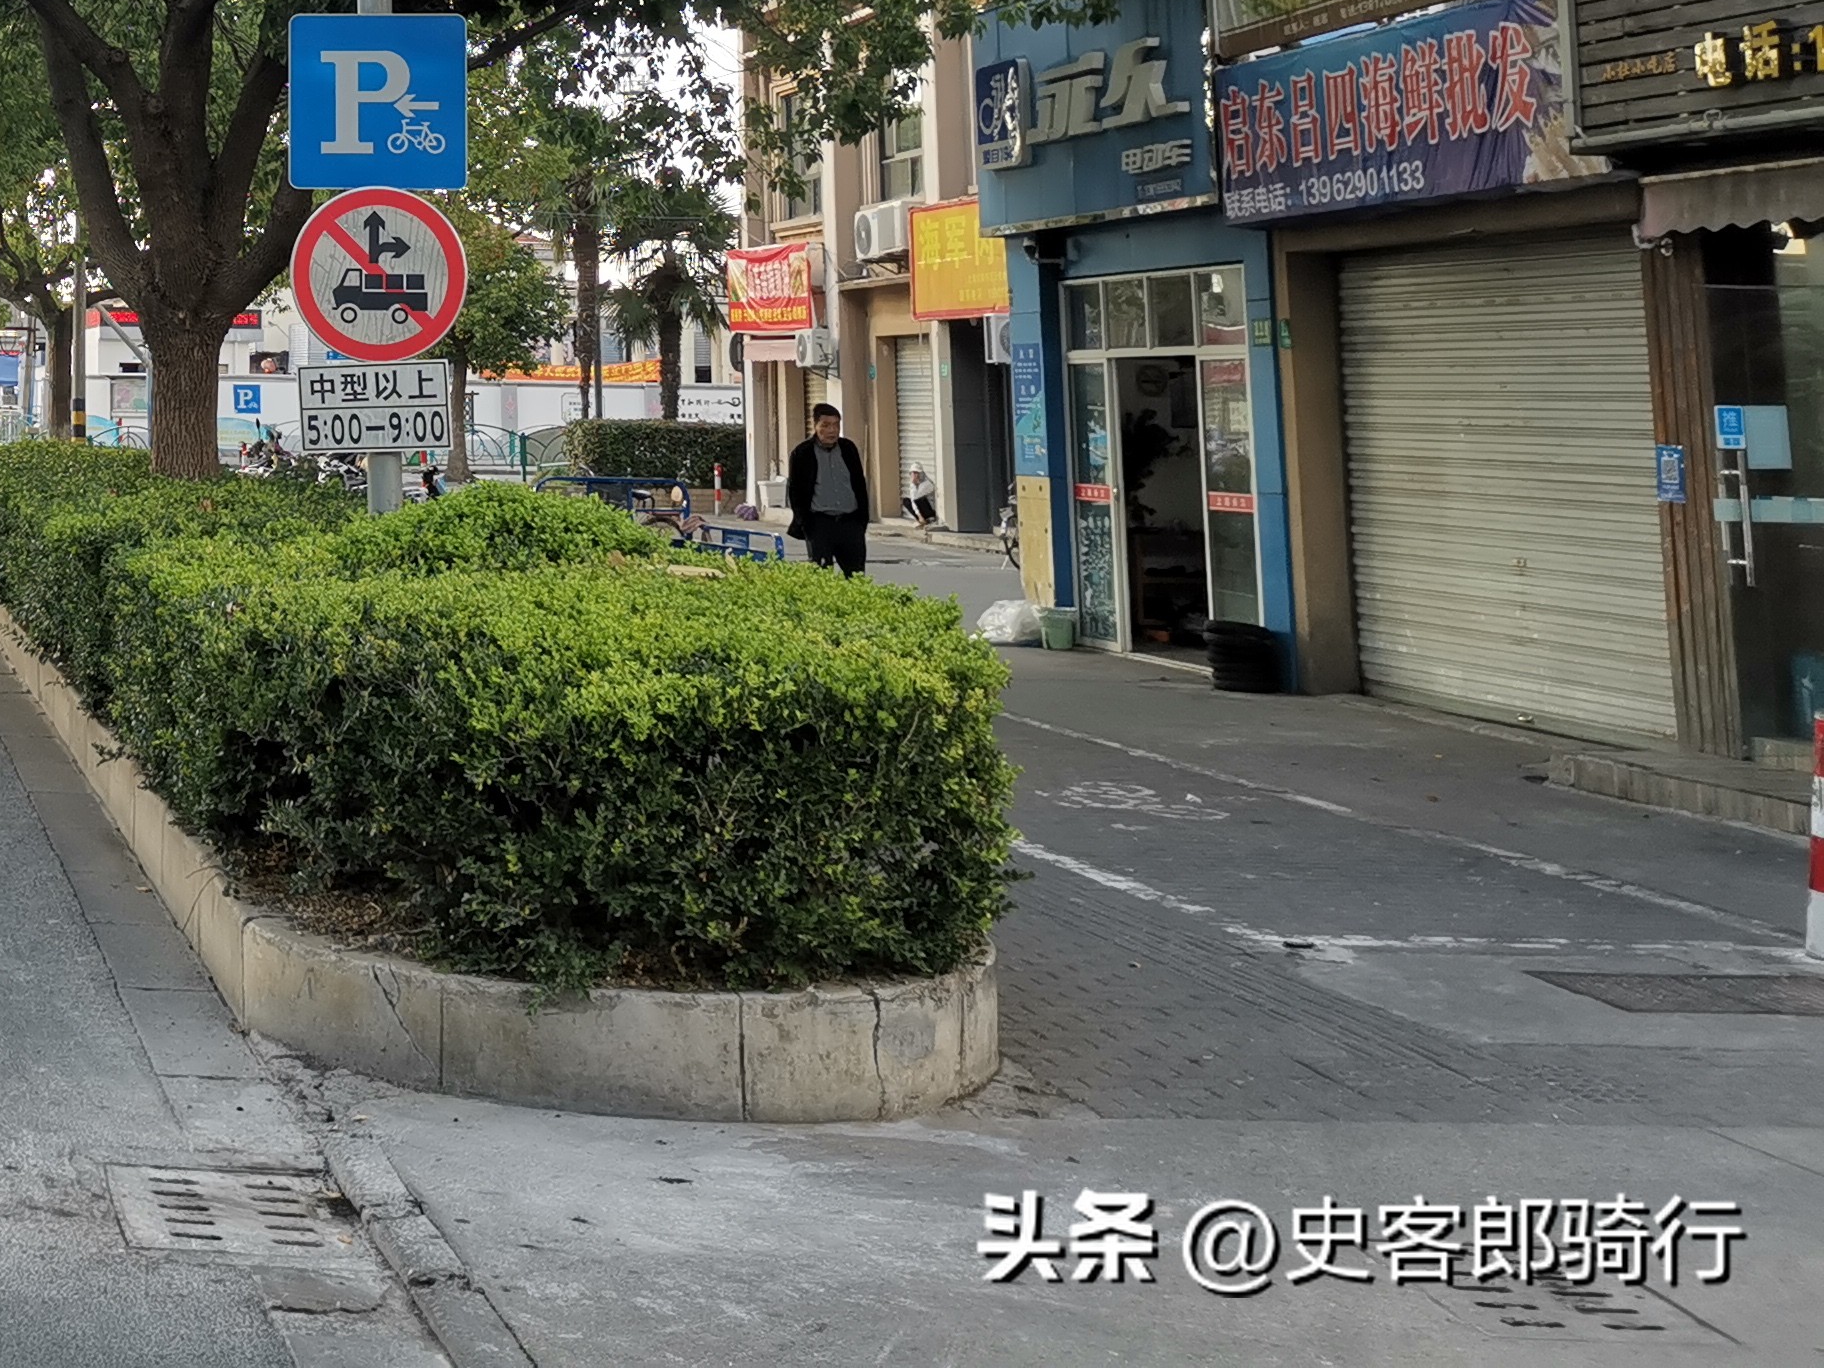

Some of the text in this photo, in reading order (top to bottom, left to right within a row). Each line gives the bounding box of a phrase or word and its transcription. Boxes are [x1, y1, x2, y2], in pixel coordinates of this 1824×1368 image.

[320, 50, 411, 155] P
[1220, 22, 1537, 180] 启东吕四海鲜批发
[1121, 139, 1192, 175] 电动车
[310, 368, 438, 405] 中型以上
